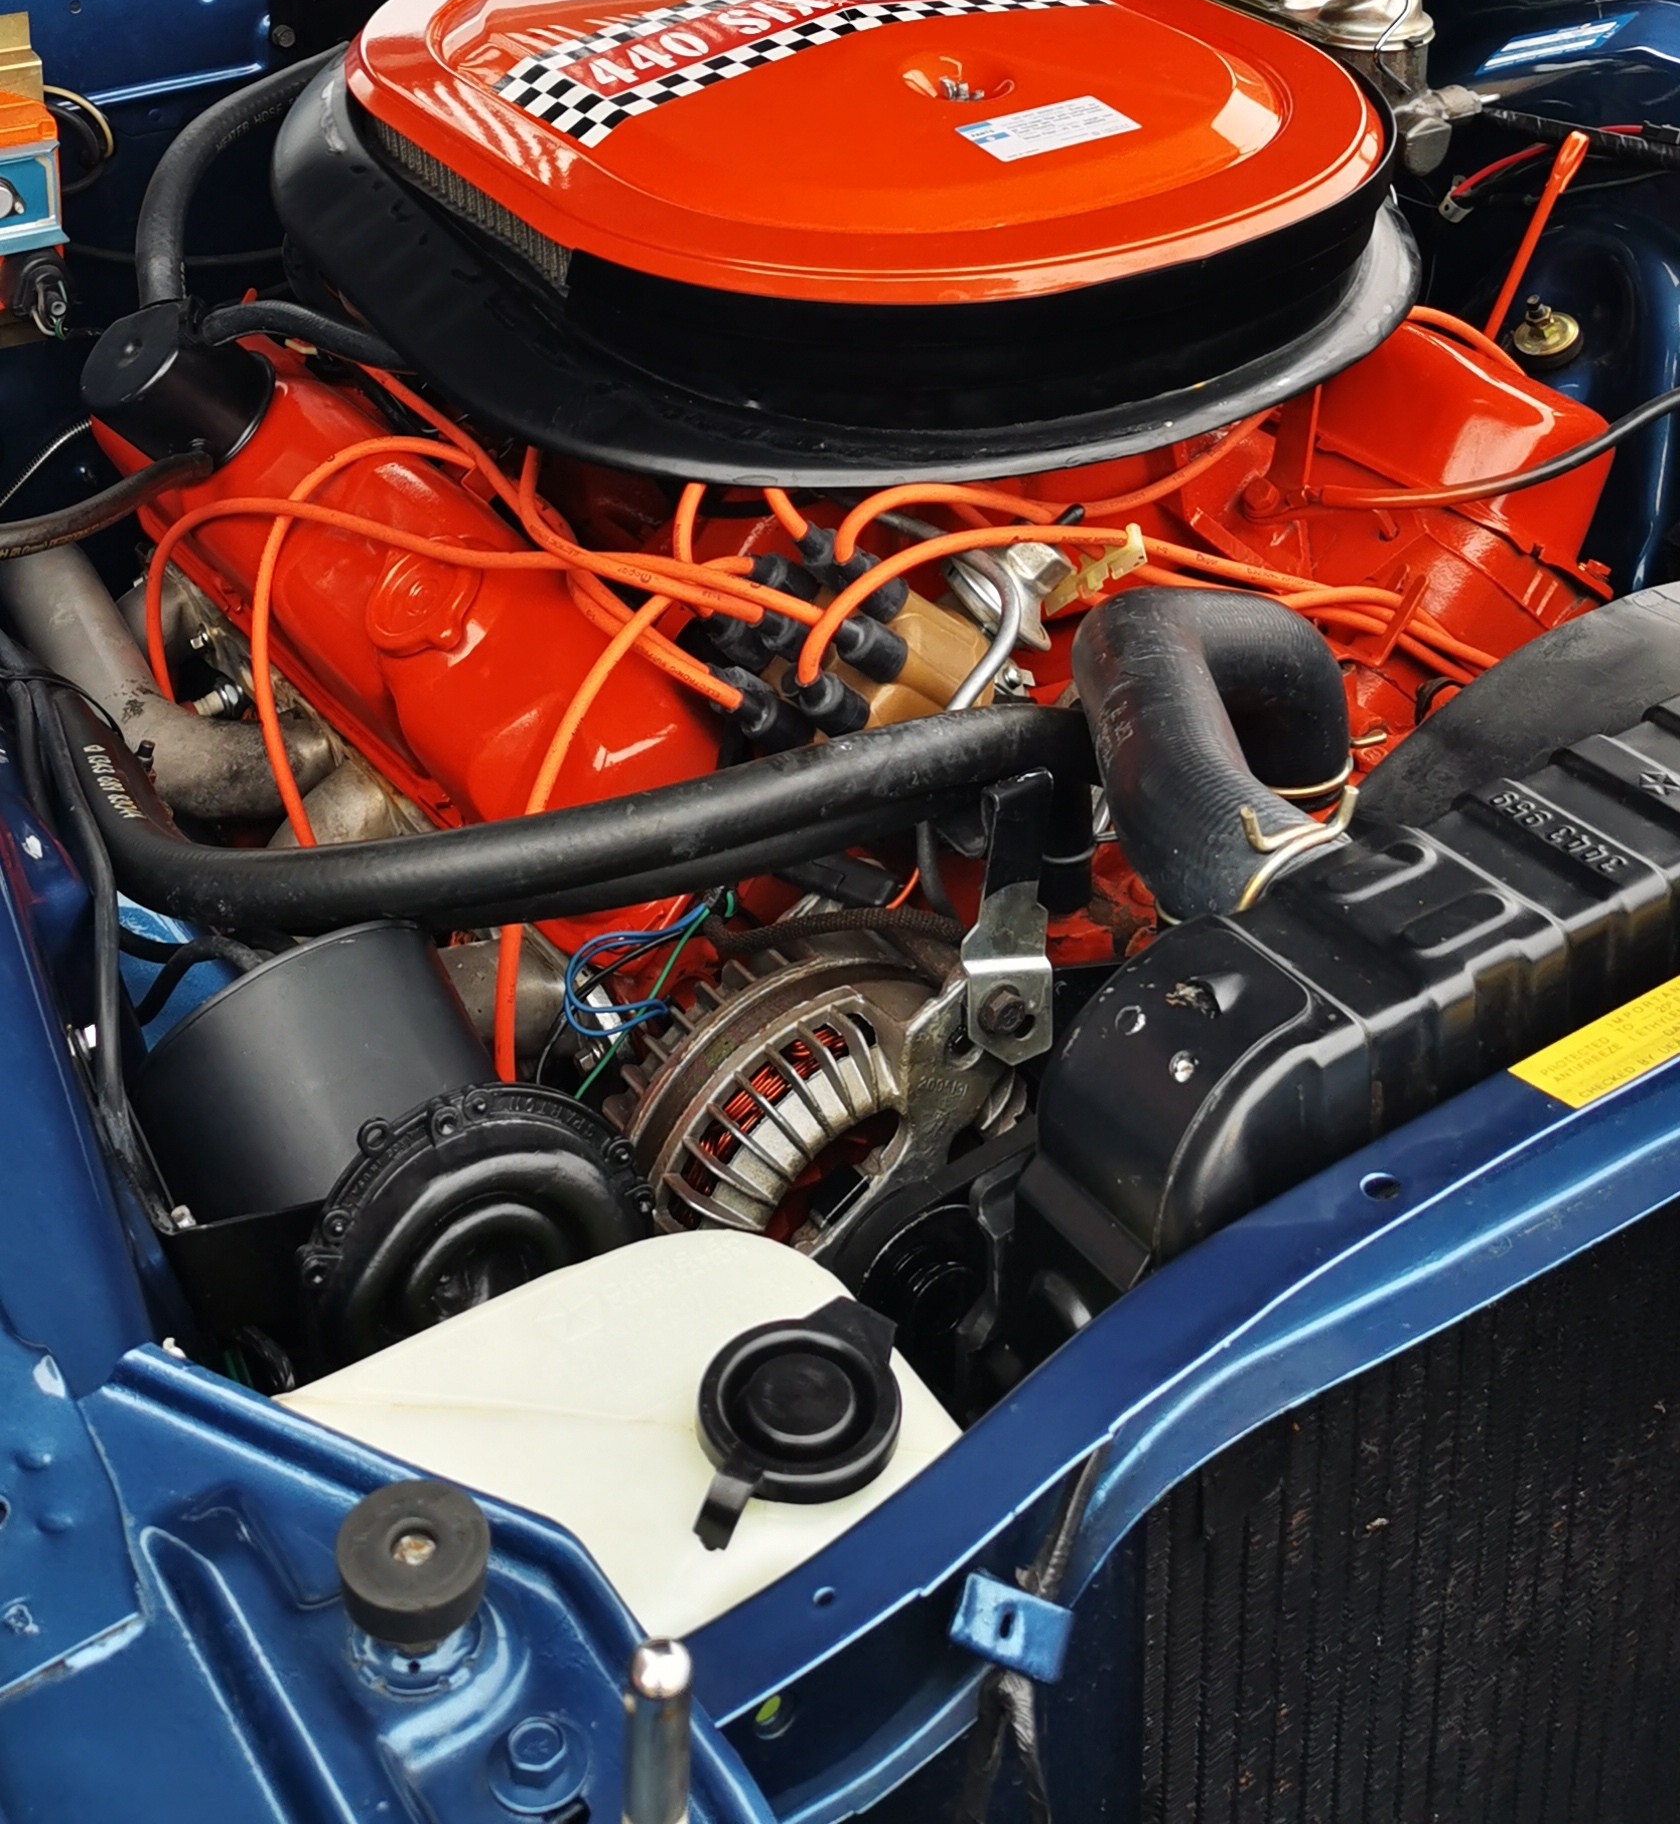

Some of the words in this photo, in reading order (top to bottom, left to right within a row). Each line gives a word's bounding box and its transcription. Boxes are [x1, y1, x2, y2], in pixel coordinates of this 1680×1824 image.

[590, 29, 711, 95] 440
[1489, 790, 1555, 829] 959
[1547, 825, 1629, 874] 3443
[1540, 1036, 1611, 1077] PROTECTED
[1617, 1022, 1634, 1035] TO
[1553, 1043, 1623, 1085] ANTIFREEZE
[1578, 1066, 1637, 1099] CHECKED
[1641, 1053, 1657, 1067] BY
